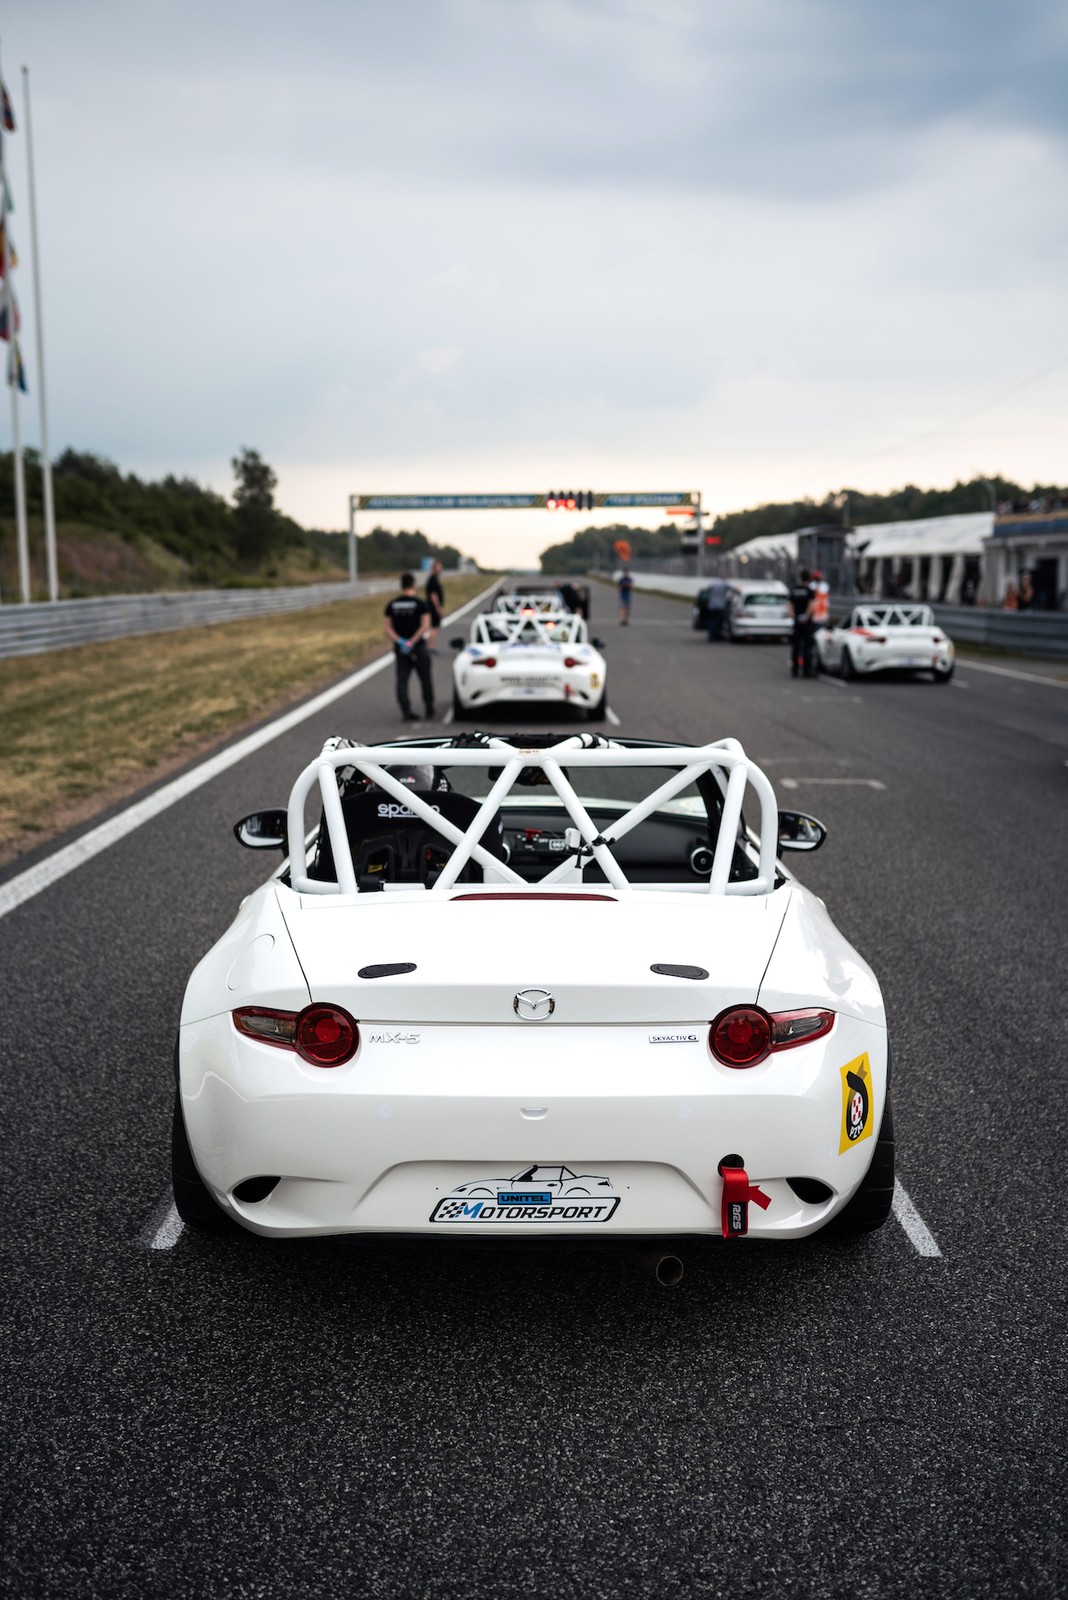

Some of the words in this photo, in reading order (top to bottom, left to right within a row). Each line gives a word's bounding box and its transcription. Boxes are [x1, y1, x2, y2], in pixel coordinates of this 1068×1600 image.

[369, 1031, 420, 1044] MX-5
[501, 1194, 549, 1203] UNITEL
[462, 1202, 608, 1219] MOTORSPORT
